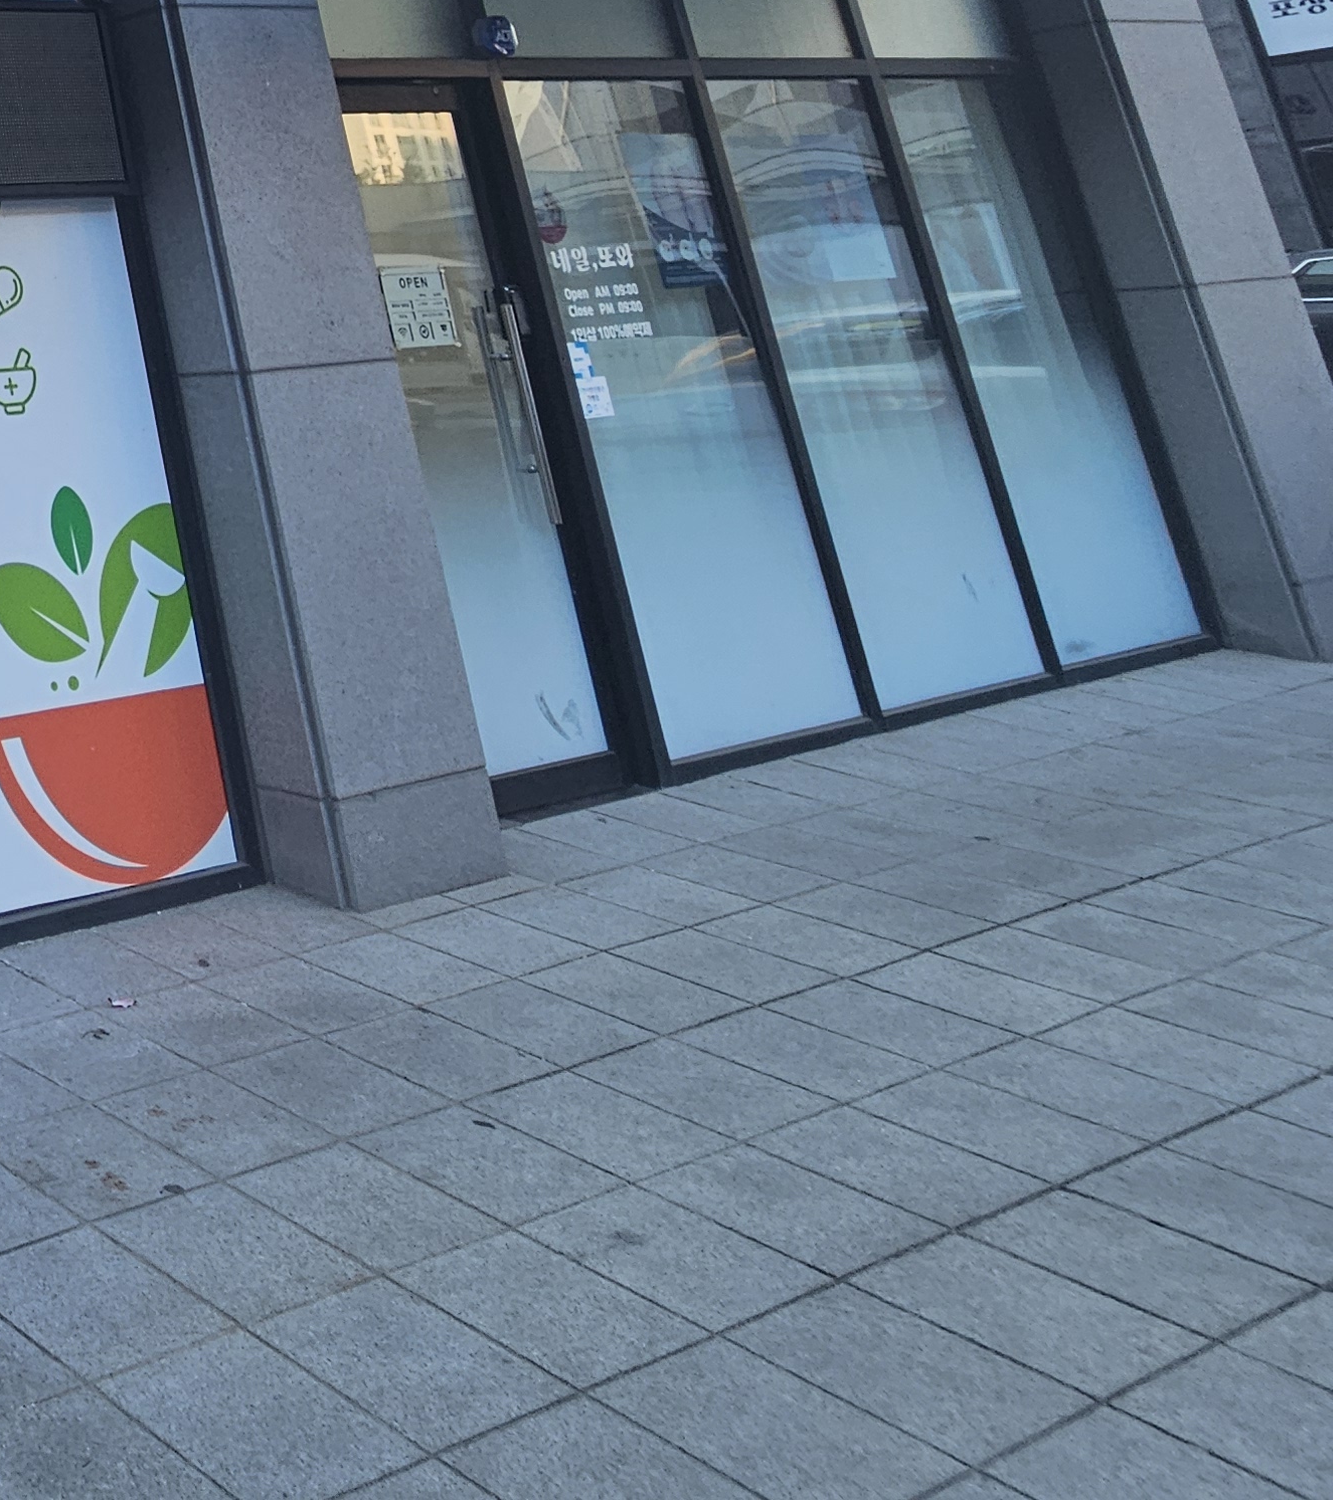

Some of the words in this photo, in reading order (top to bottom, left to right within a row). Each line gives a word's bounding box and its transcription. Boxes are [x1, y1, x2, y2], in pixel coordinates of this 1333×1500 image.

[549, 243, 635, 273] 네일,또와
[398, 277, 429, 289] OPEN
[564, 287, 590, 302] Open
[594, 285, 612, 298] AM
[568, 304, 595, 318] Close
[598, 303, 615, 316] PM
